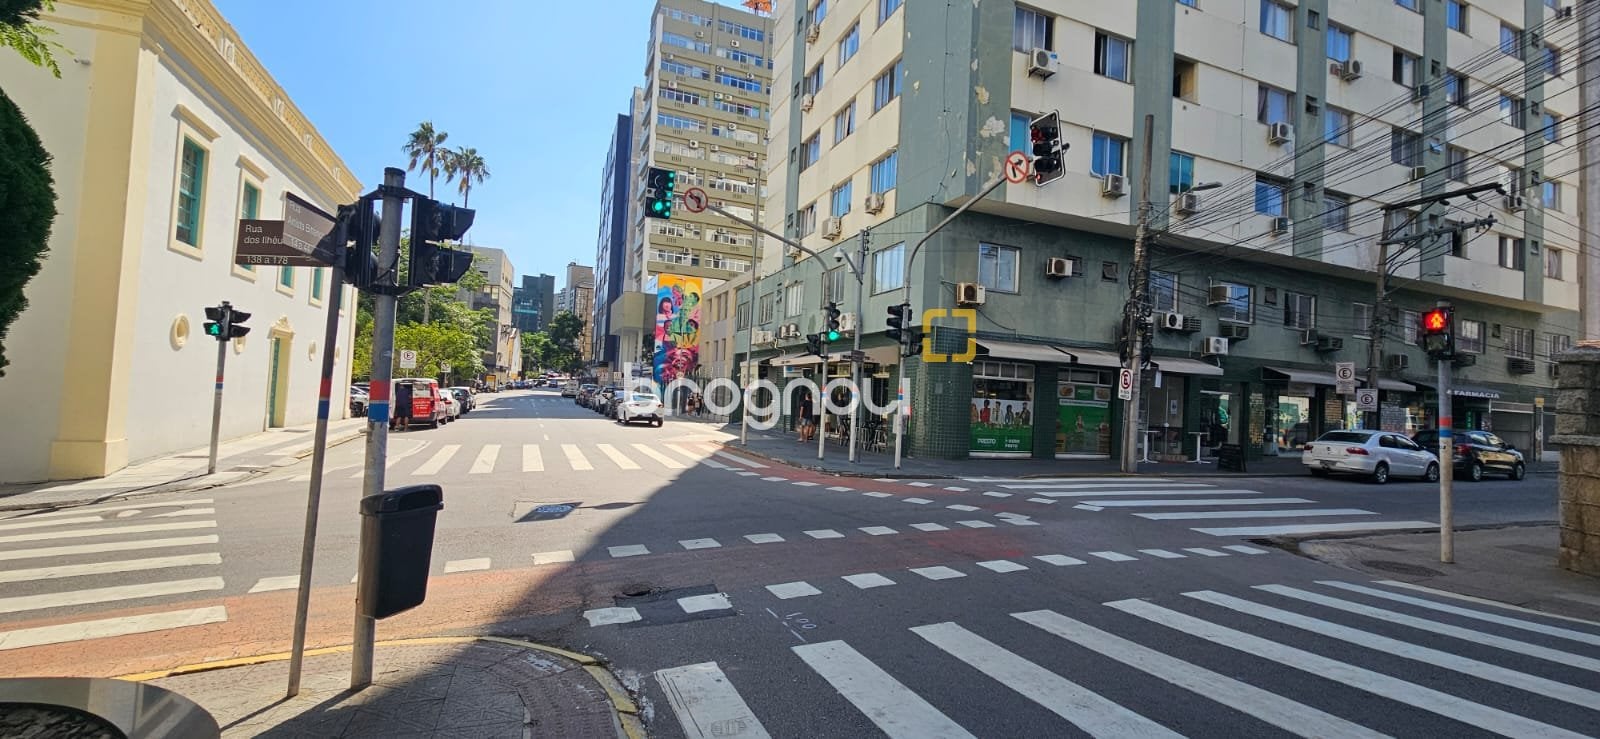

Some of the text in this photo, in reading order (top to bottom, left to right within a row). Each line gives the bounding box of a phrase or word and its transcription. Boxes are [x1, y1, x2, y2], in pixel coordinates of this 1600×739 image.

[245, 224, 262, 233] Rua
[243, 235, 284, 245] dos Ilhéu
[247, 255, 262, 264] 138
[273, 255, 288, 265] 178
